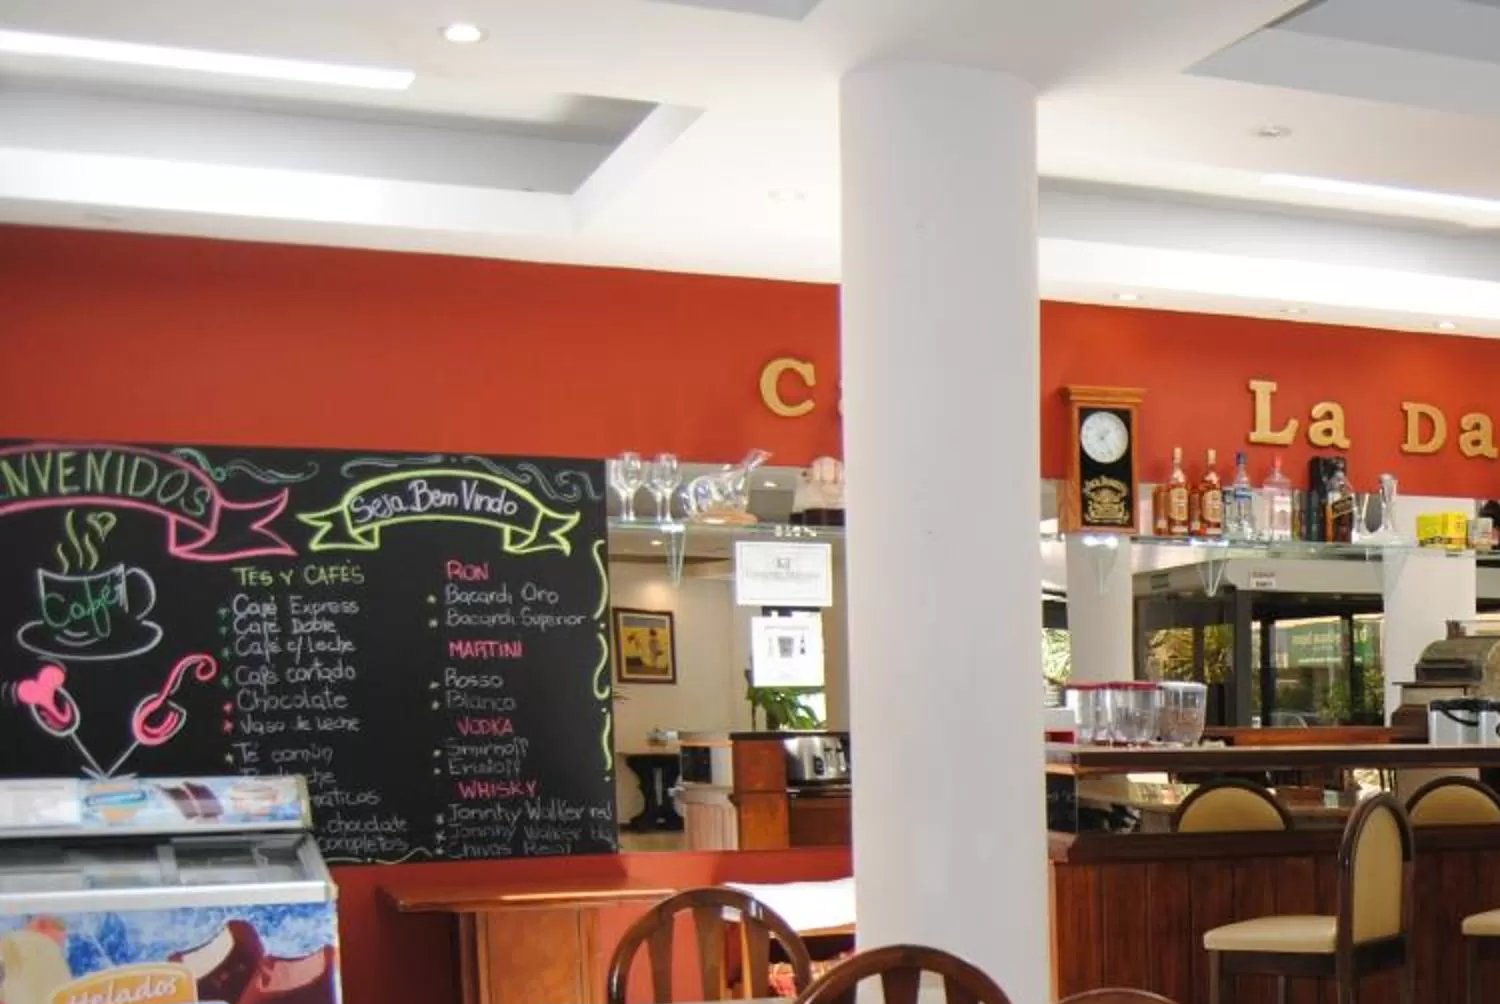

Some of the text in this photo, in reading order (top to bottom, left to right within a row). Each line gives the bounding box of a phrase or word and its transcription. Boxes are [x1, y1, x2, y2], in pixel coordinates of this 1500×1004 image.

[1249, 379, 1350, 449] La
[350, 479, 519, 523] Seja Bem Vindo
[446, 560, 489, 581] RON
[520, 581, 560, 605] Oro
[448, 639, 523, 660] MARTINI
[456, 715, 515, 737] VODKA
[456, 779, 537, 798] WHISKY
